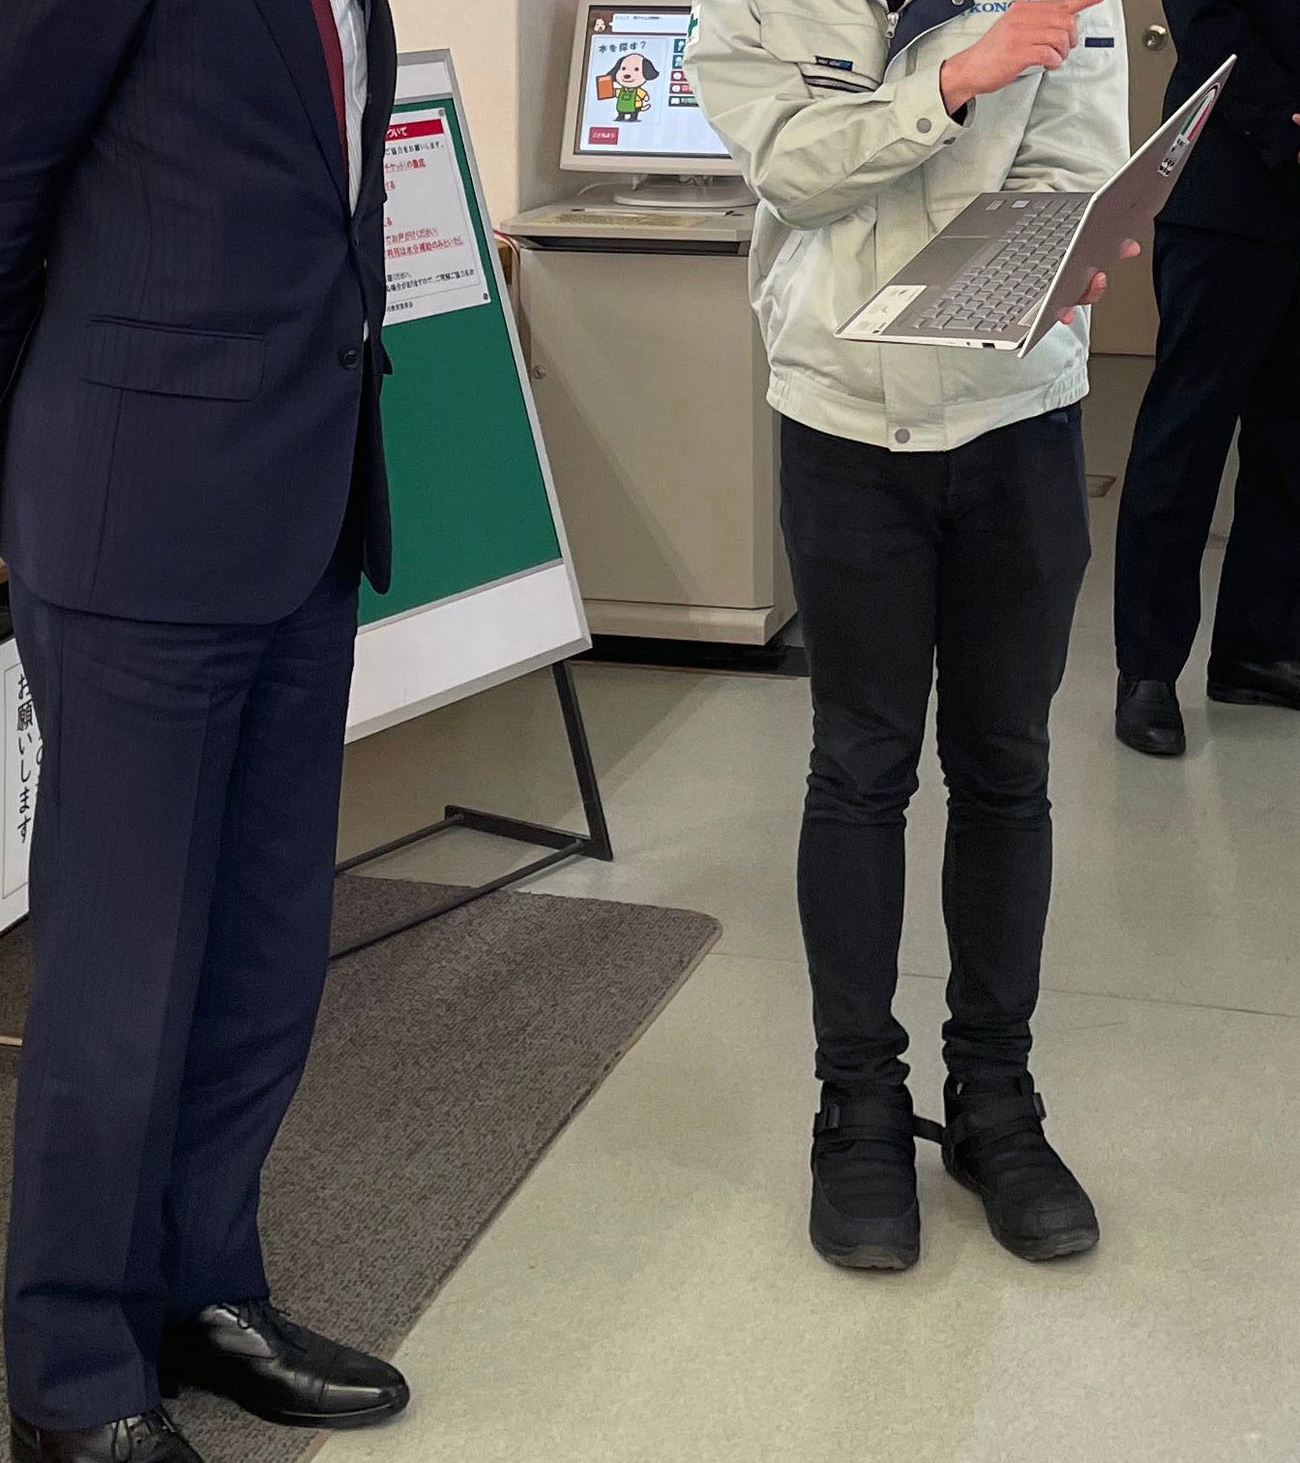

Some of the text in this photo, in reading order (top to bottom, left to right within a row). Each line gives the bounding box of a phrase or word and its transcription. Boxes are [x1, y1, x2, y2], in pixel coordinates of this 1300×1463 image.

[17, 673, 35, 844] お願いします
